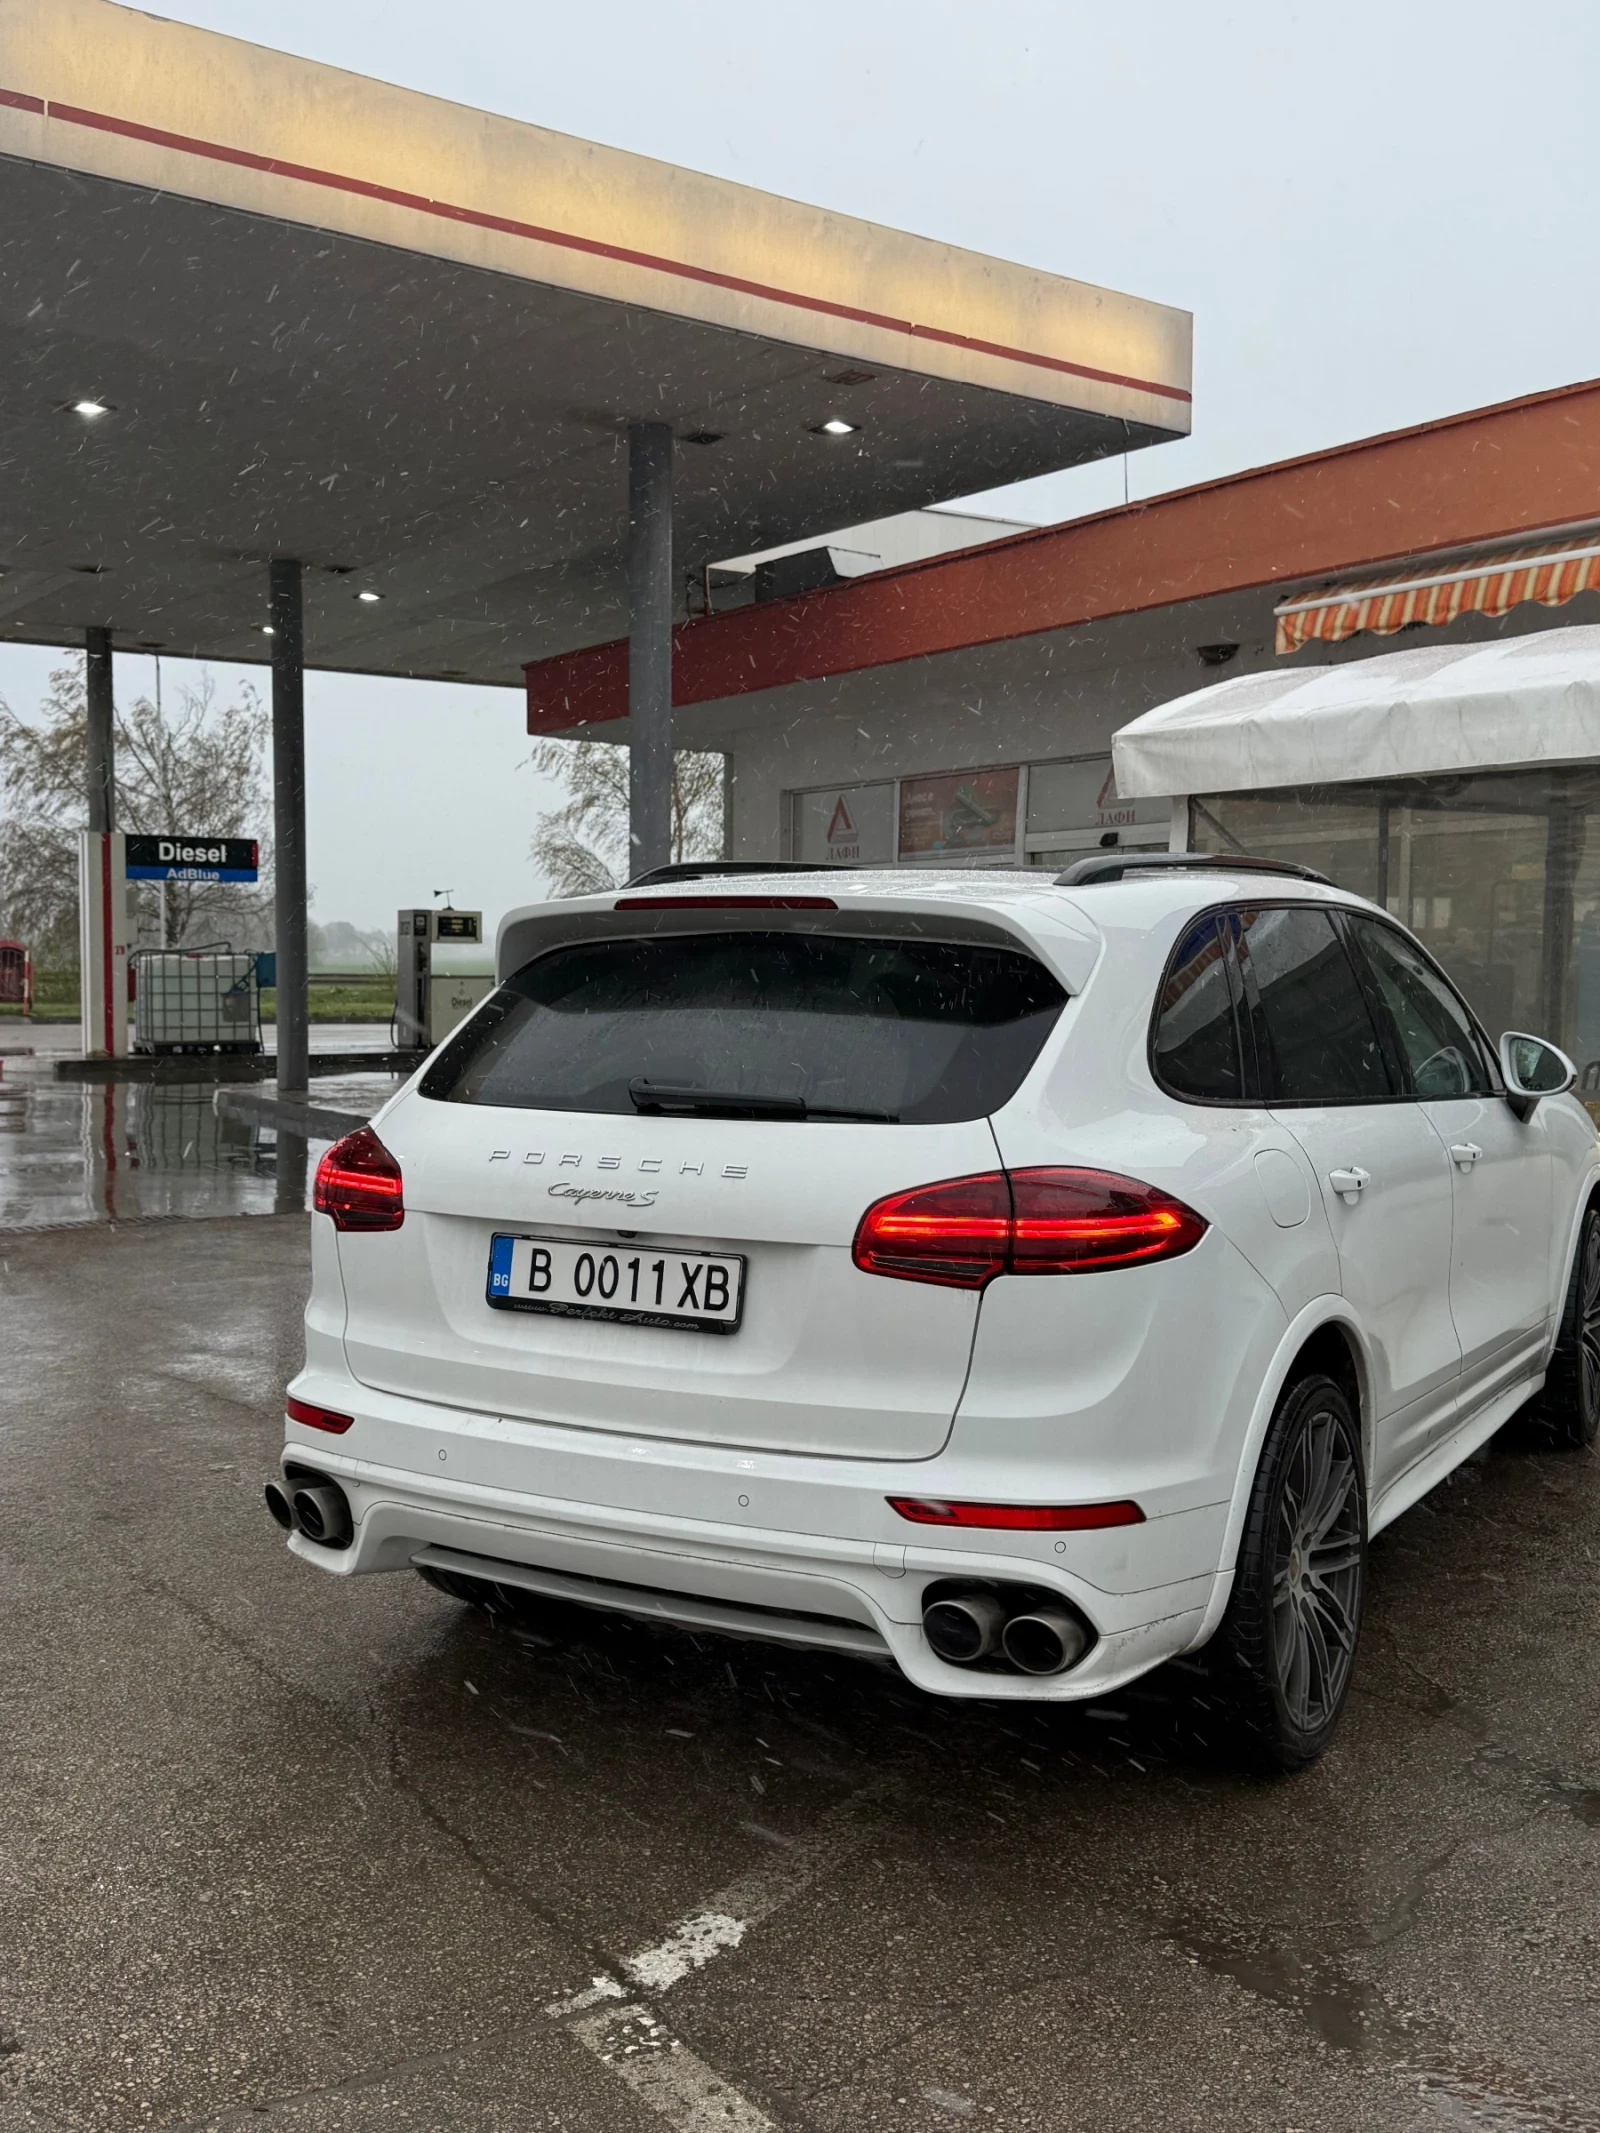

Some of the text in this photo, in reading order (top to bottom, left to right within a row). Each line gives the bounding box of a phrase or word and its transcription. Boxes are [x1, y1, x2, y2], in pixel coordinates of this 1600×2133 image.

[1095, 810, 1135, 826] ЛАФИ
[159, 842, 227, 863] Diesel
[826, 846, 860, 861] ЛАФИ
[166, 868, 220, 881] AdBlue
[488, 1149, 749, 1179] PORSCHE
[548, 1182, 659, 1207] Cayenne S
[528, 1248, 552, 1292] B
[493, 1273, 509, 1288] BG
